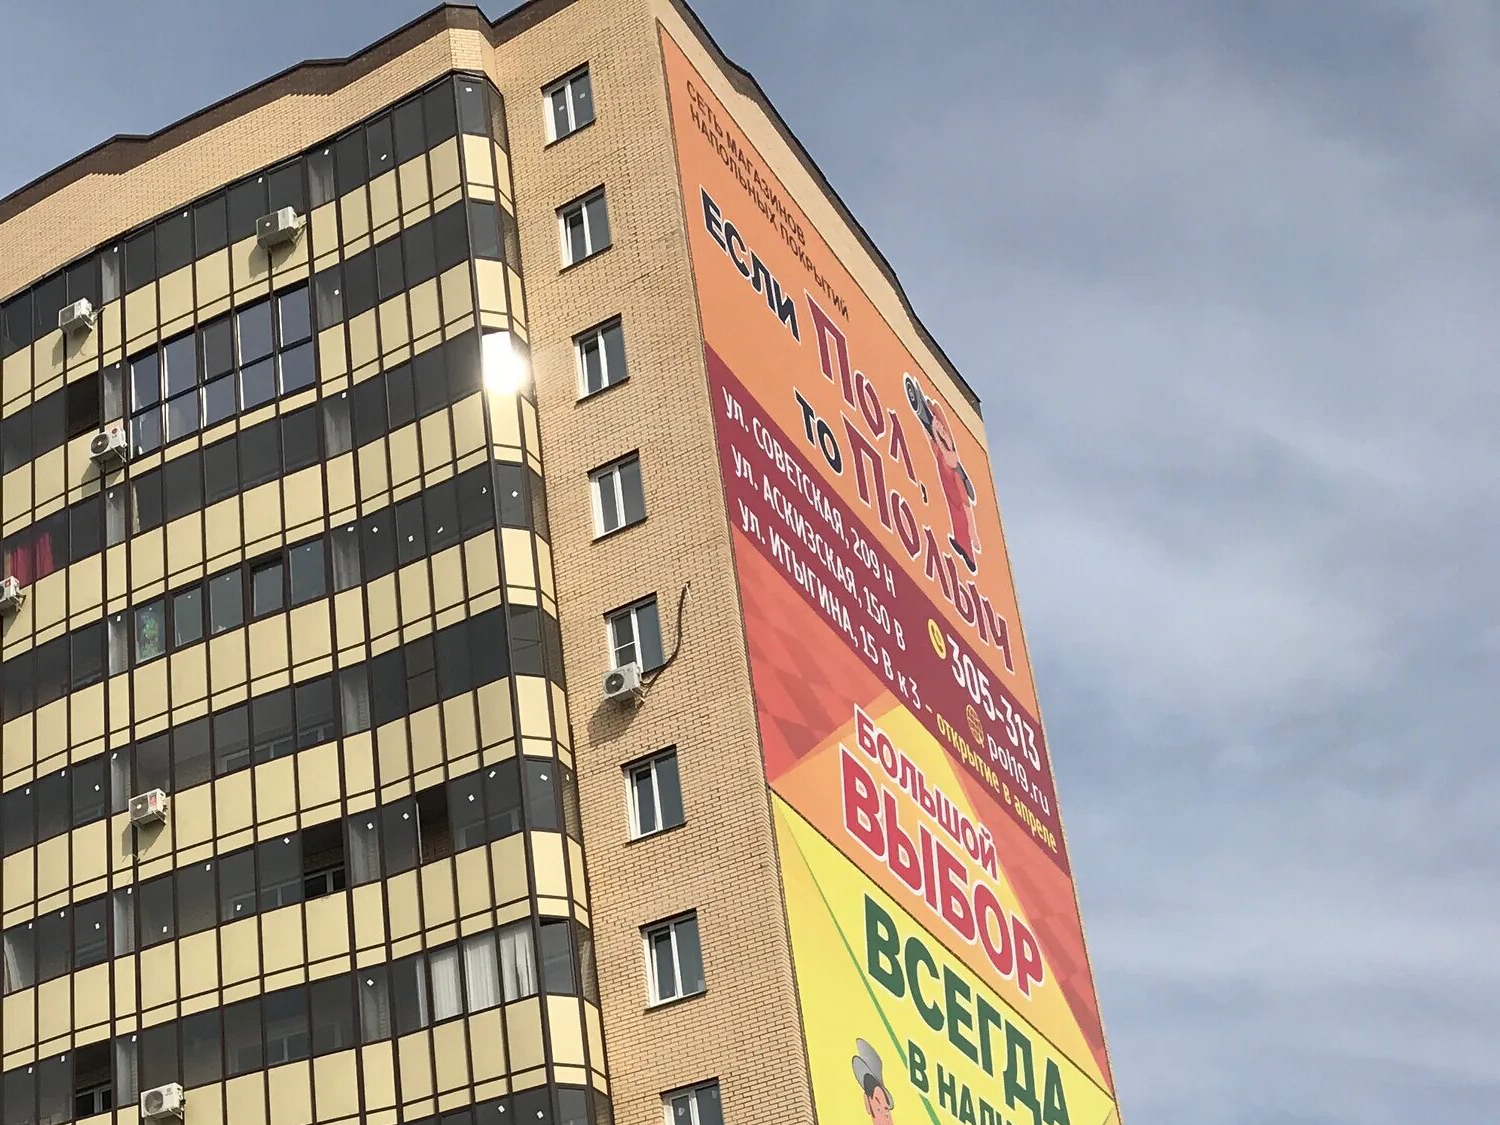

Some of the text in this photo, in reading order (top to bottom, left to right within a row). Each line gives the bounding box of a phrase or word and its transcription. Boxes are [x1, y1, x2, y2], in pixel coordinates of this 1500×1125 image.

[687, 80, 805, 246] СЕТЬ МАГАЗИНОВ
[690, 103, 850, 323] НАПОЛЬНЫХ ПОКРЫТИЙ
[700, 185, 801, 343] ЕСЛИ
[753, 416, 850, 548] СОВЕТСКАЯ,
[850, 526, 881, 580] 209
[763, 474, 862, 604] АСКИЗСКАЯ,
[863, 586, 891, 635] 150
[841, 411, 1015, 675] Полыч
[769, 532, 859, 648] ИТЫГИНА,
[860, 624, 878, 666] 15
[936, 713, 1000, 794] открытие
[1014, 795, 1057, 853] апреле
[947, 634, 1041, 771] 305-313
[986, 733, 1050, 816] pol19.ru
[839, 742, 1045, 999] ВЫБОР
[853, 704, 1000, 883] БОЛЬШОЙ
